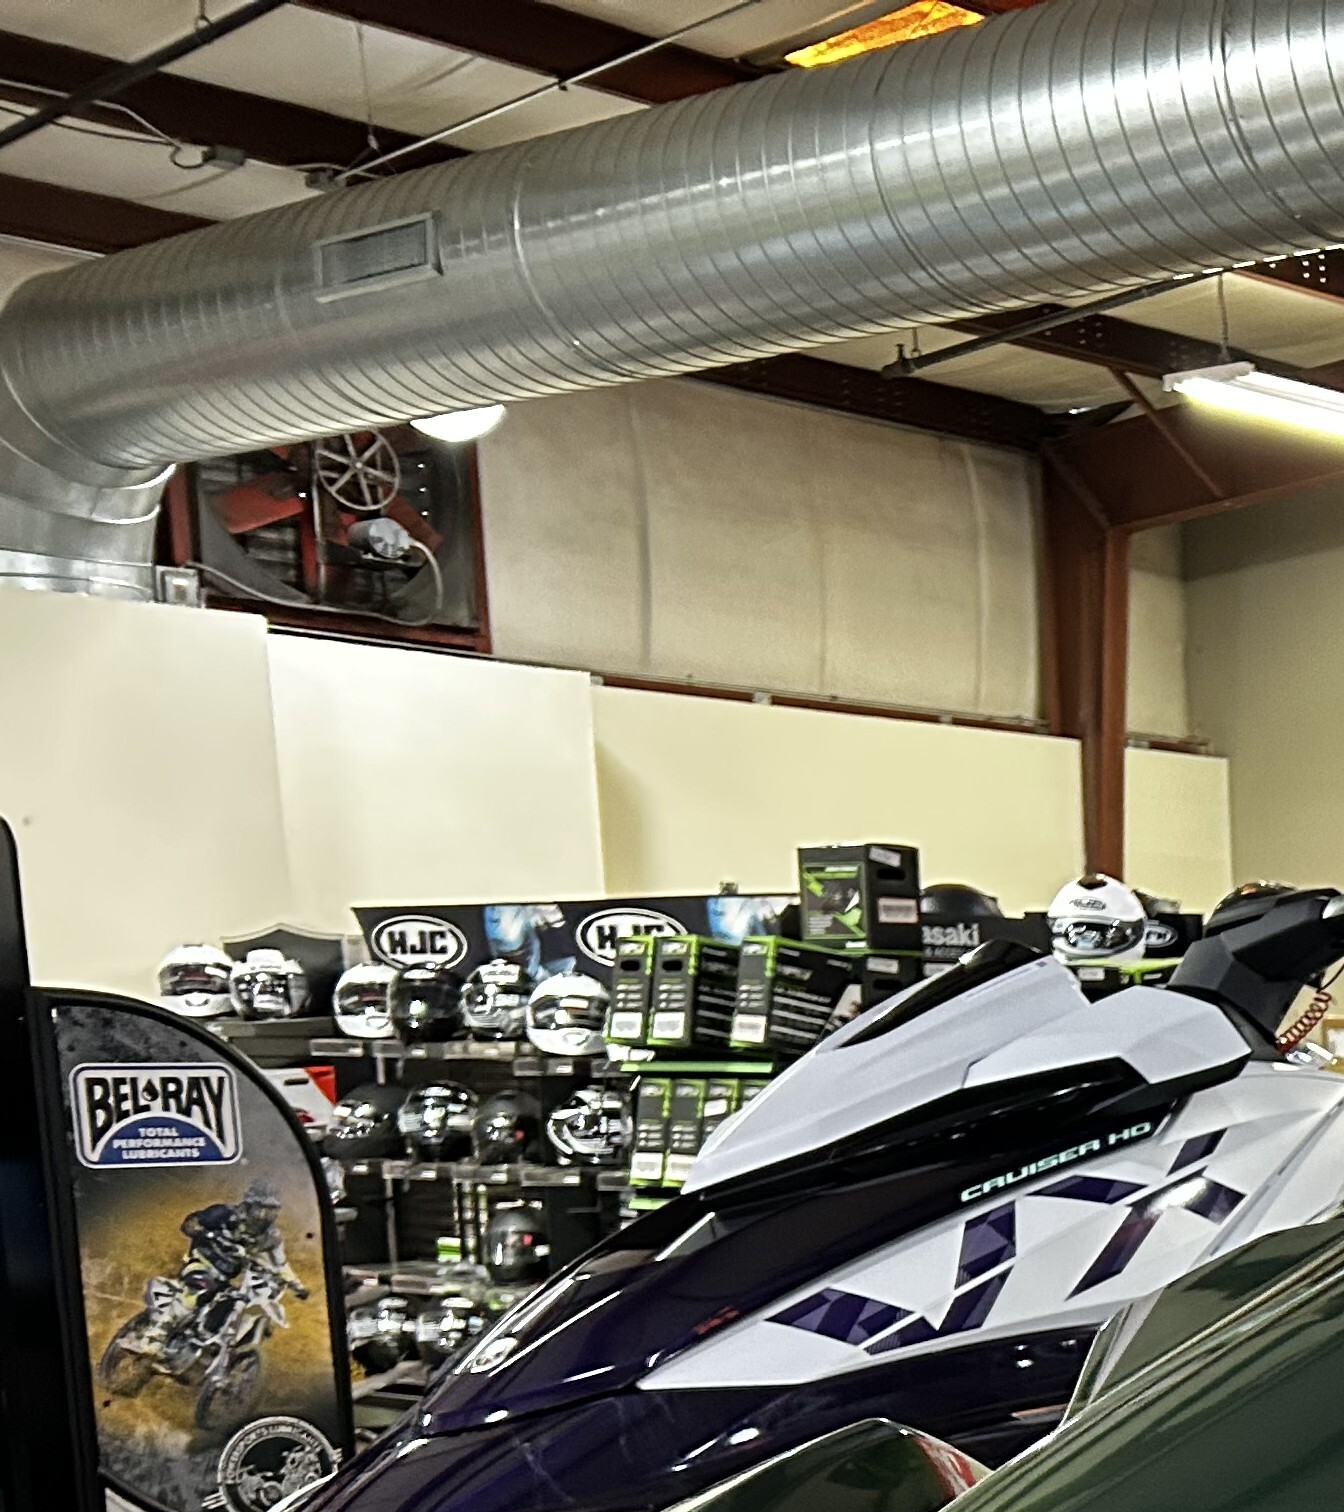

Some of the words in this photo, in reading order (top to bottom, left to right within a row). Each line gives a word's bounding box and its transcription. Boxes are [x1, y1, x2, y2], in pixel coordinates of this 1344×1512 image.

[387, 930, 449, 955] HJC
[138, 1127, 180, 1138] TOTAL
[112, 1137, 207, 1149] PERFORMANCE
[121, 1148, 200, 1160] LUBRICANTS
[960, 1138, 1101, 1203] CRUISER
[1108, 1121, 1152, 1146] HD
